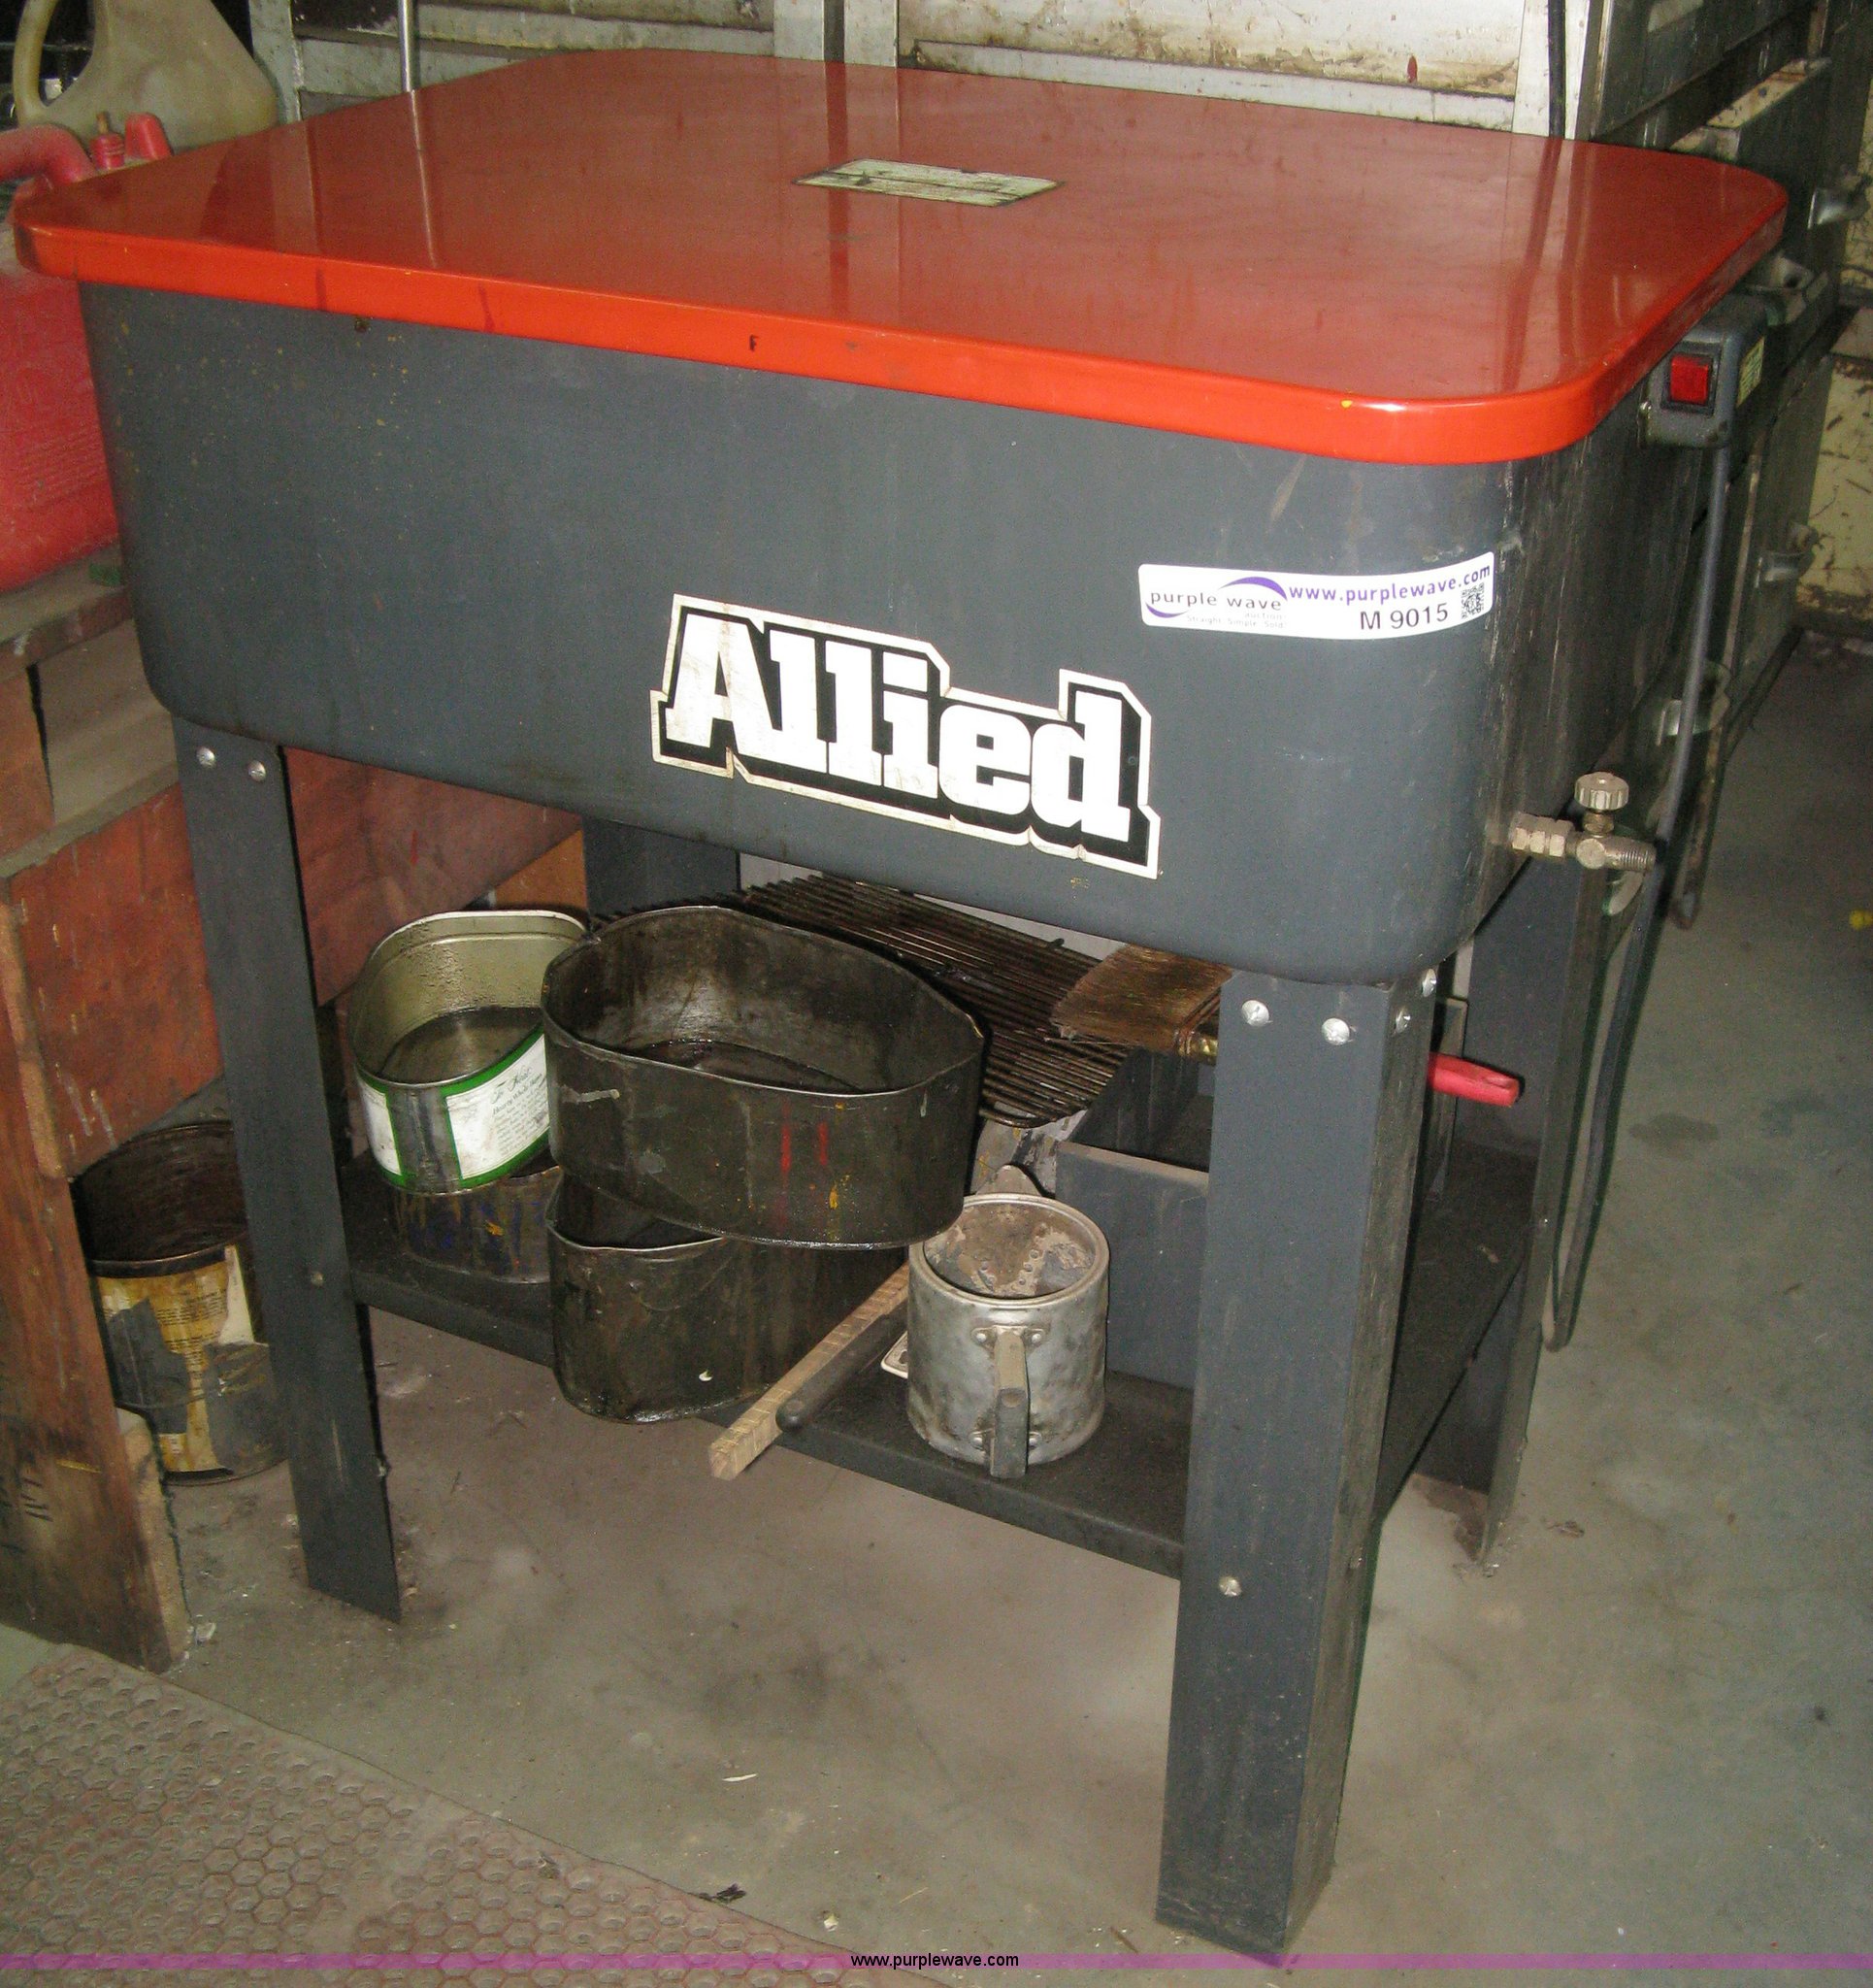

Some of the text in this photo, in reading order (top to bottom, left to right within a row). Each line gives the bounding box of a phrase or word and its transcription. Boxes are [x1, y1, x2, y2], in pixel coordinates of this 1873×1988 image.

[1150, 591, 1282, 611] purple wave
[1289, 564, 1491, 606] www.purplewave.com
[1360, 602, 1449, 631] M 9015
[665, 613, 1131, 843] Allied
